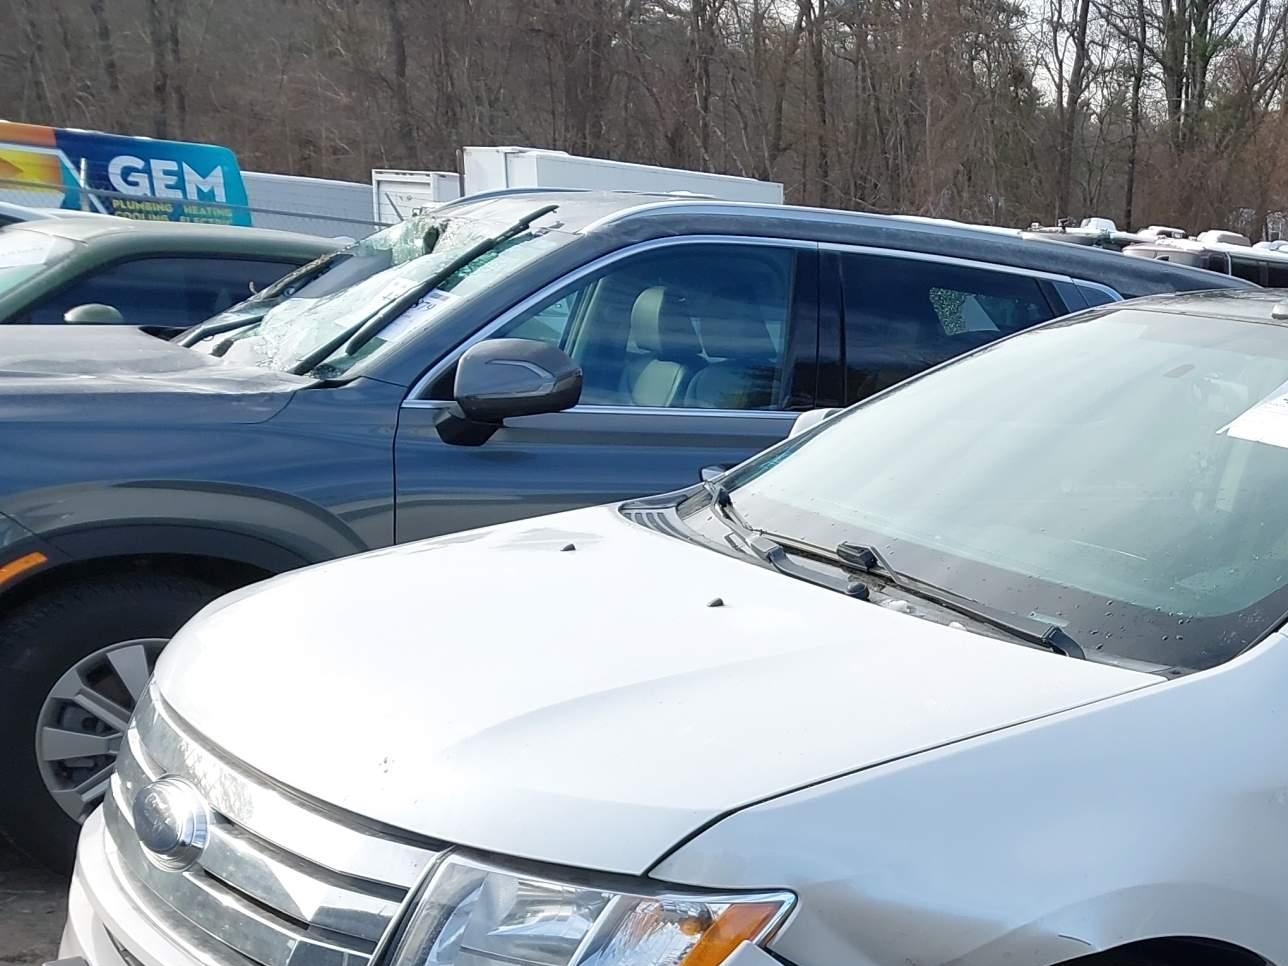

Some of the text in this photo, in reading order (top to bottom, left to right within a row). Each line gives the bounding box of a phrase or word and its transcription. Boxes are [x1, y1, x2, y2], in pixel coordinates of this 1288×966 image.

[107, 155, 226, 202] GEM
[112, 199, 233, 217] PLUMBING HEATING
